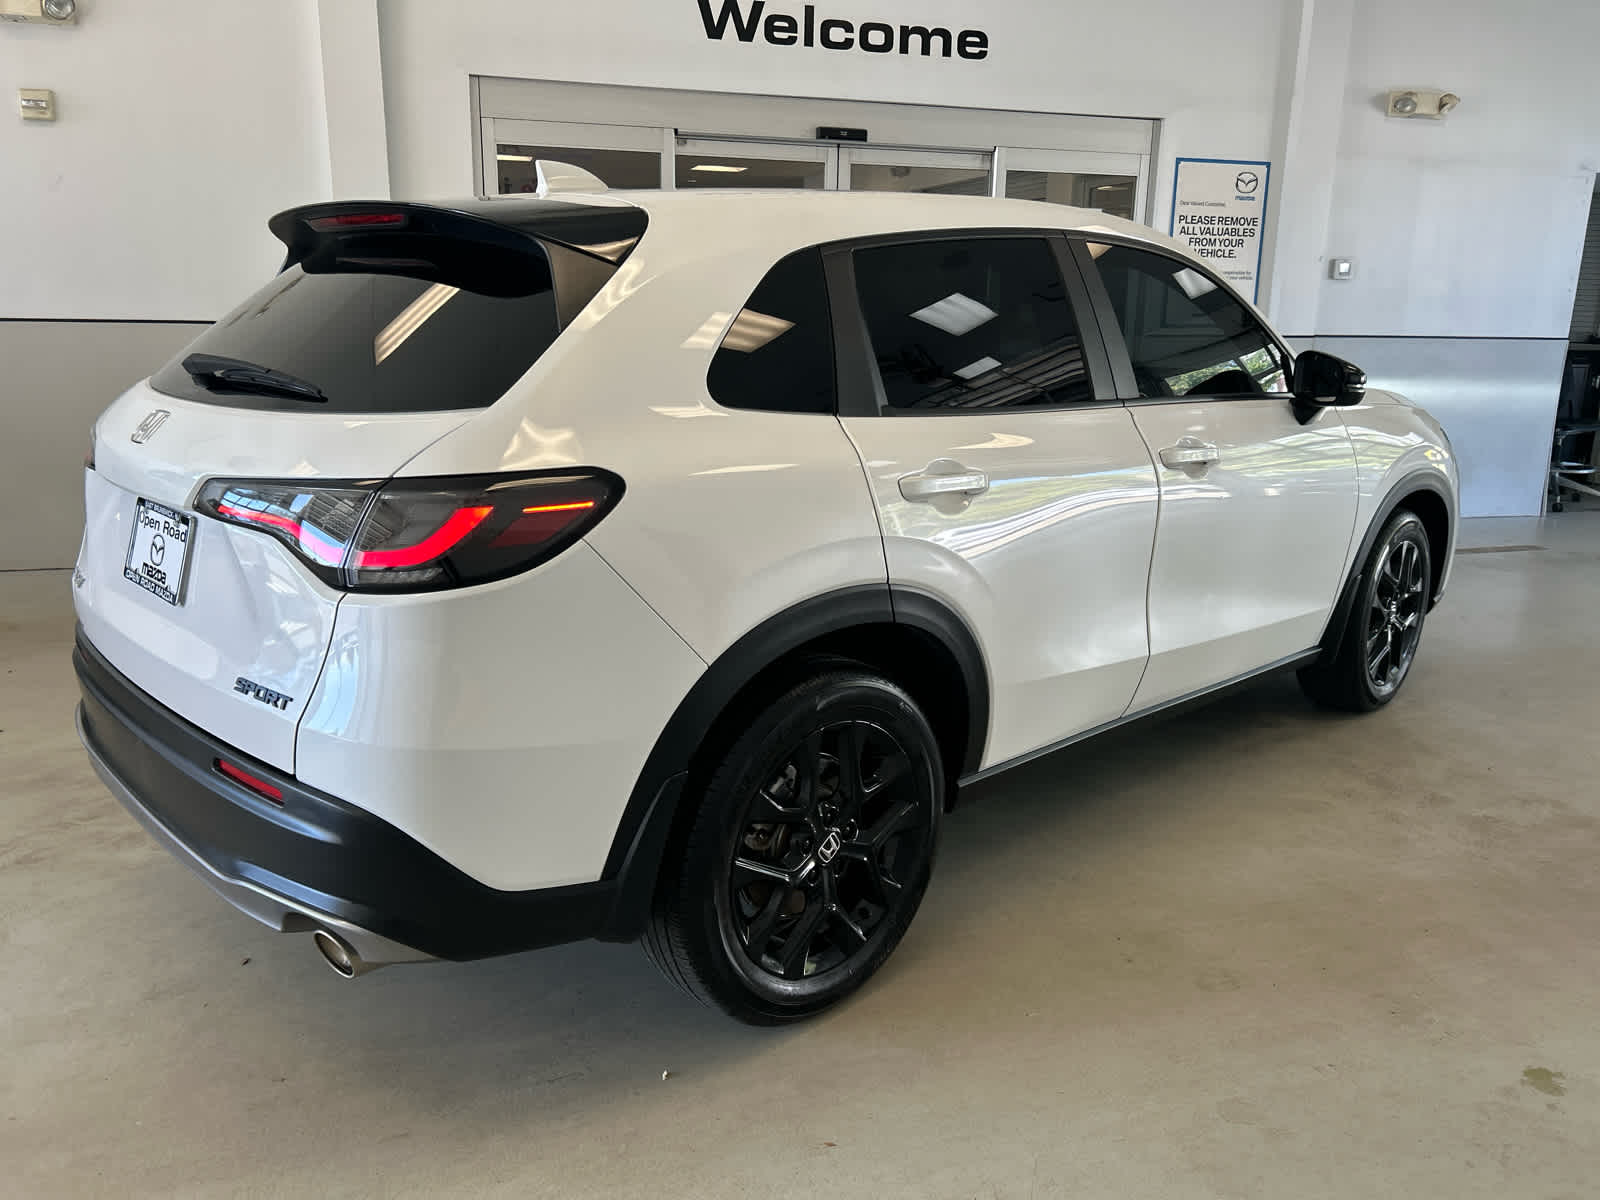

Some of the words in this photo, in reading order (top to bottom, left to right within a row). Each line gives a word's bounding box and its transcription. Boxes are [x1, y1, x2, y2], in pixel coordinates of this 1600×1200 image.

[697, 0, 989, 60] Welcome
[1179, 215, 1216, 226] PLEASE
[1217, 217, 1259, 227] REMOVE
[1180, 226, 1199, 236] ALL
[1200, 227, 1255, 237] VALUABLES
[1189, 237, 1216, 247] FROM
[1218, 238, 1244, 248] YOUR
[140, 510, 160, 531] Open
[163, 520, 187, 542] Road
[142, 562, 167, 585] mazda
[233, 676, 294, 710] SPORT
